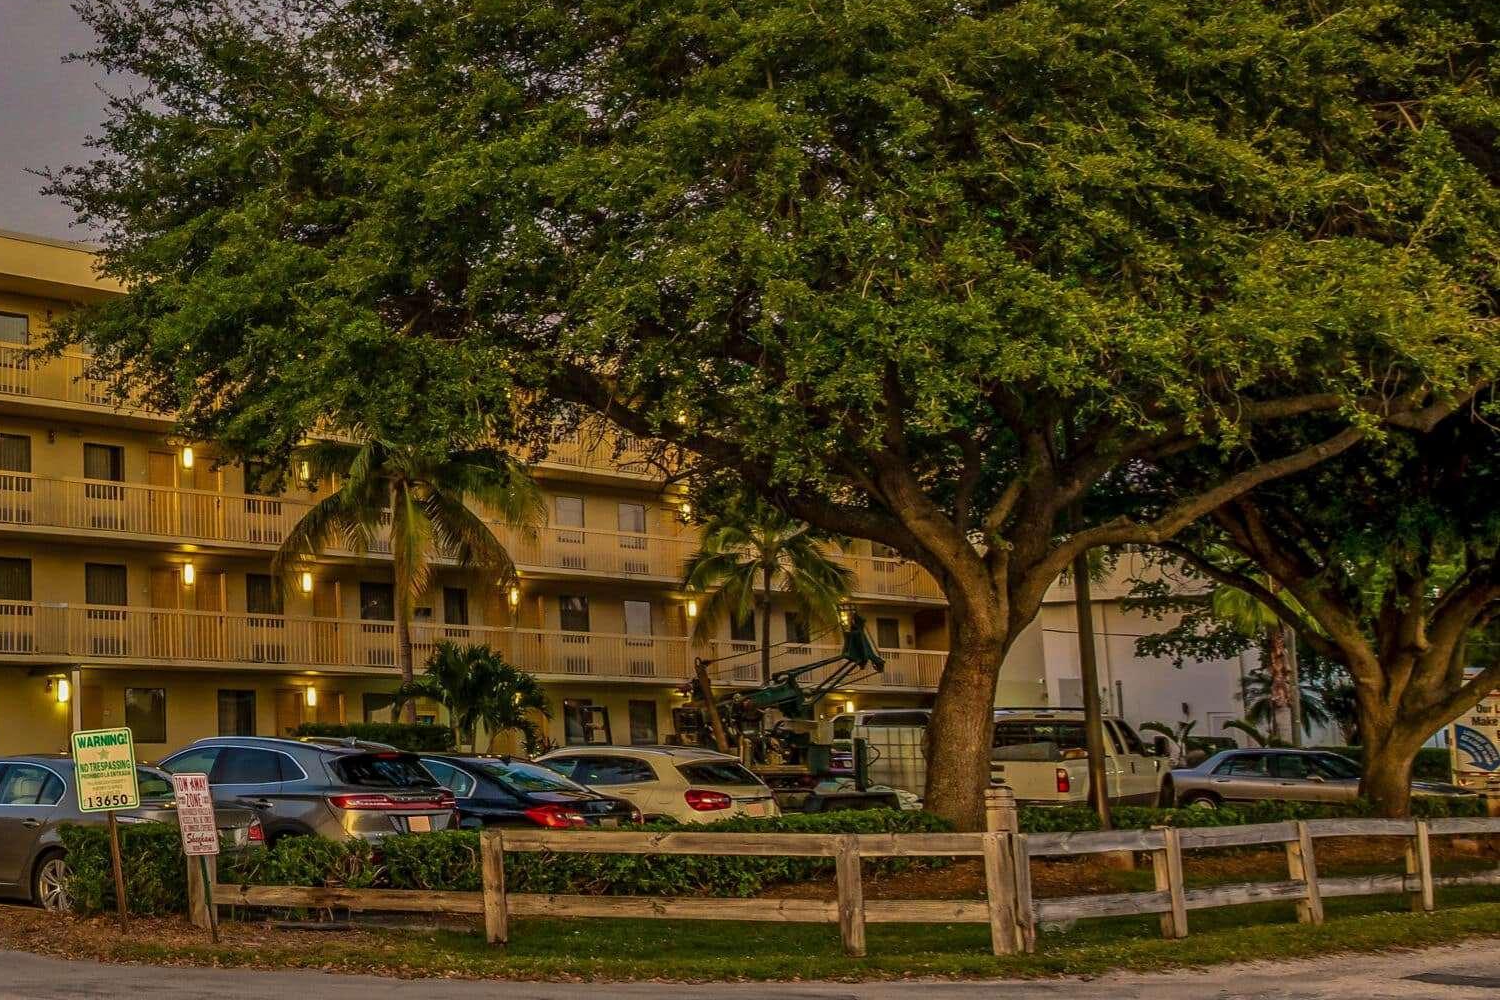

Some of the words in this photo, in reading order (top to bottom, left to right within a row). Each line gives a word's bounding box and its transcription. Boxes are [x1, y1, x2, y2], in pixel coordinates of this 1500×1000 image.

[1471, 717, 1498, 727] Make
[77, 733, 128, 749] WARNING!
[80, 763, 89, 773] NO
[89, 760, 131, 772] TRESPASSING
[88, 794, 128, 808] 13650
[185, 793, 202, 807] ZONE
